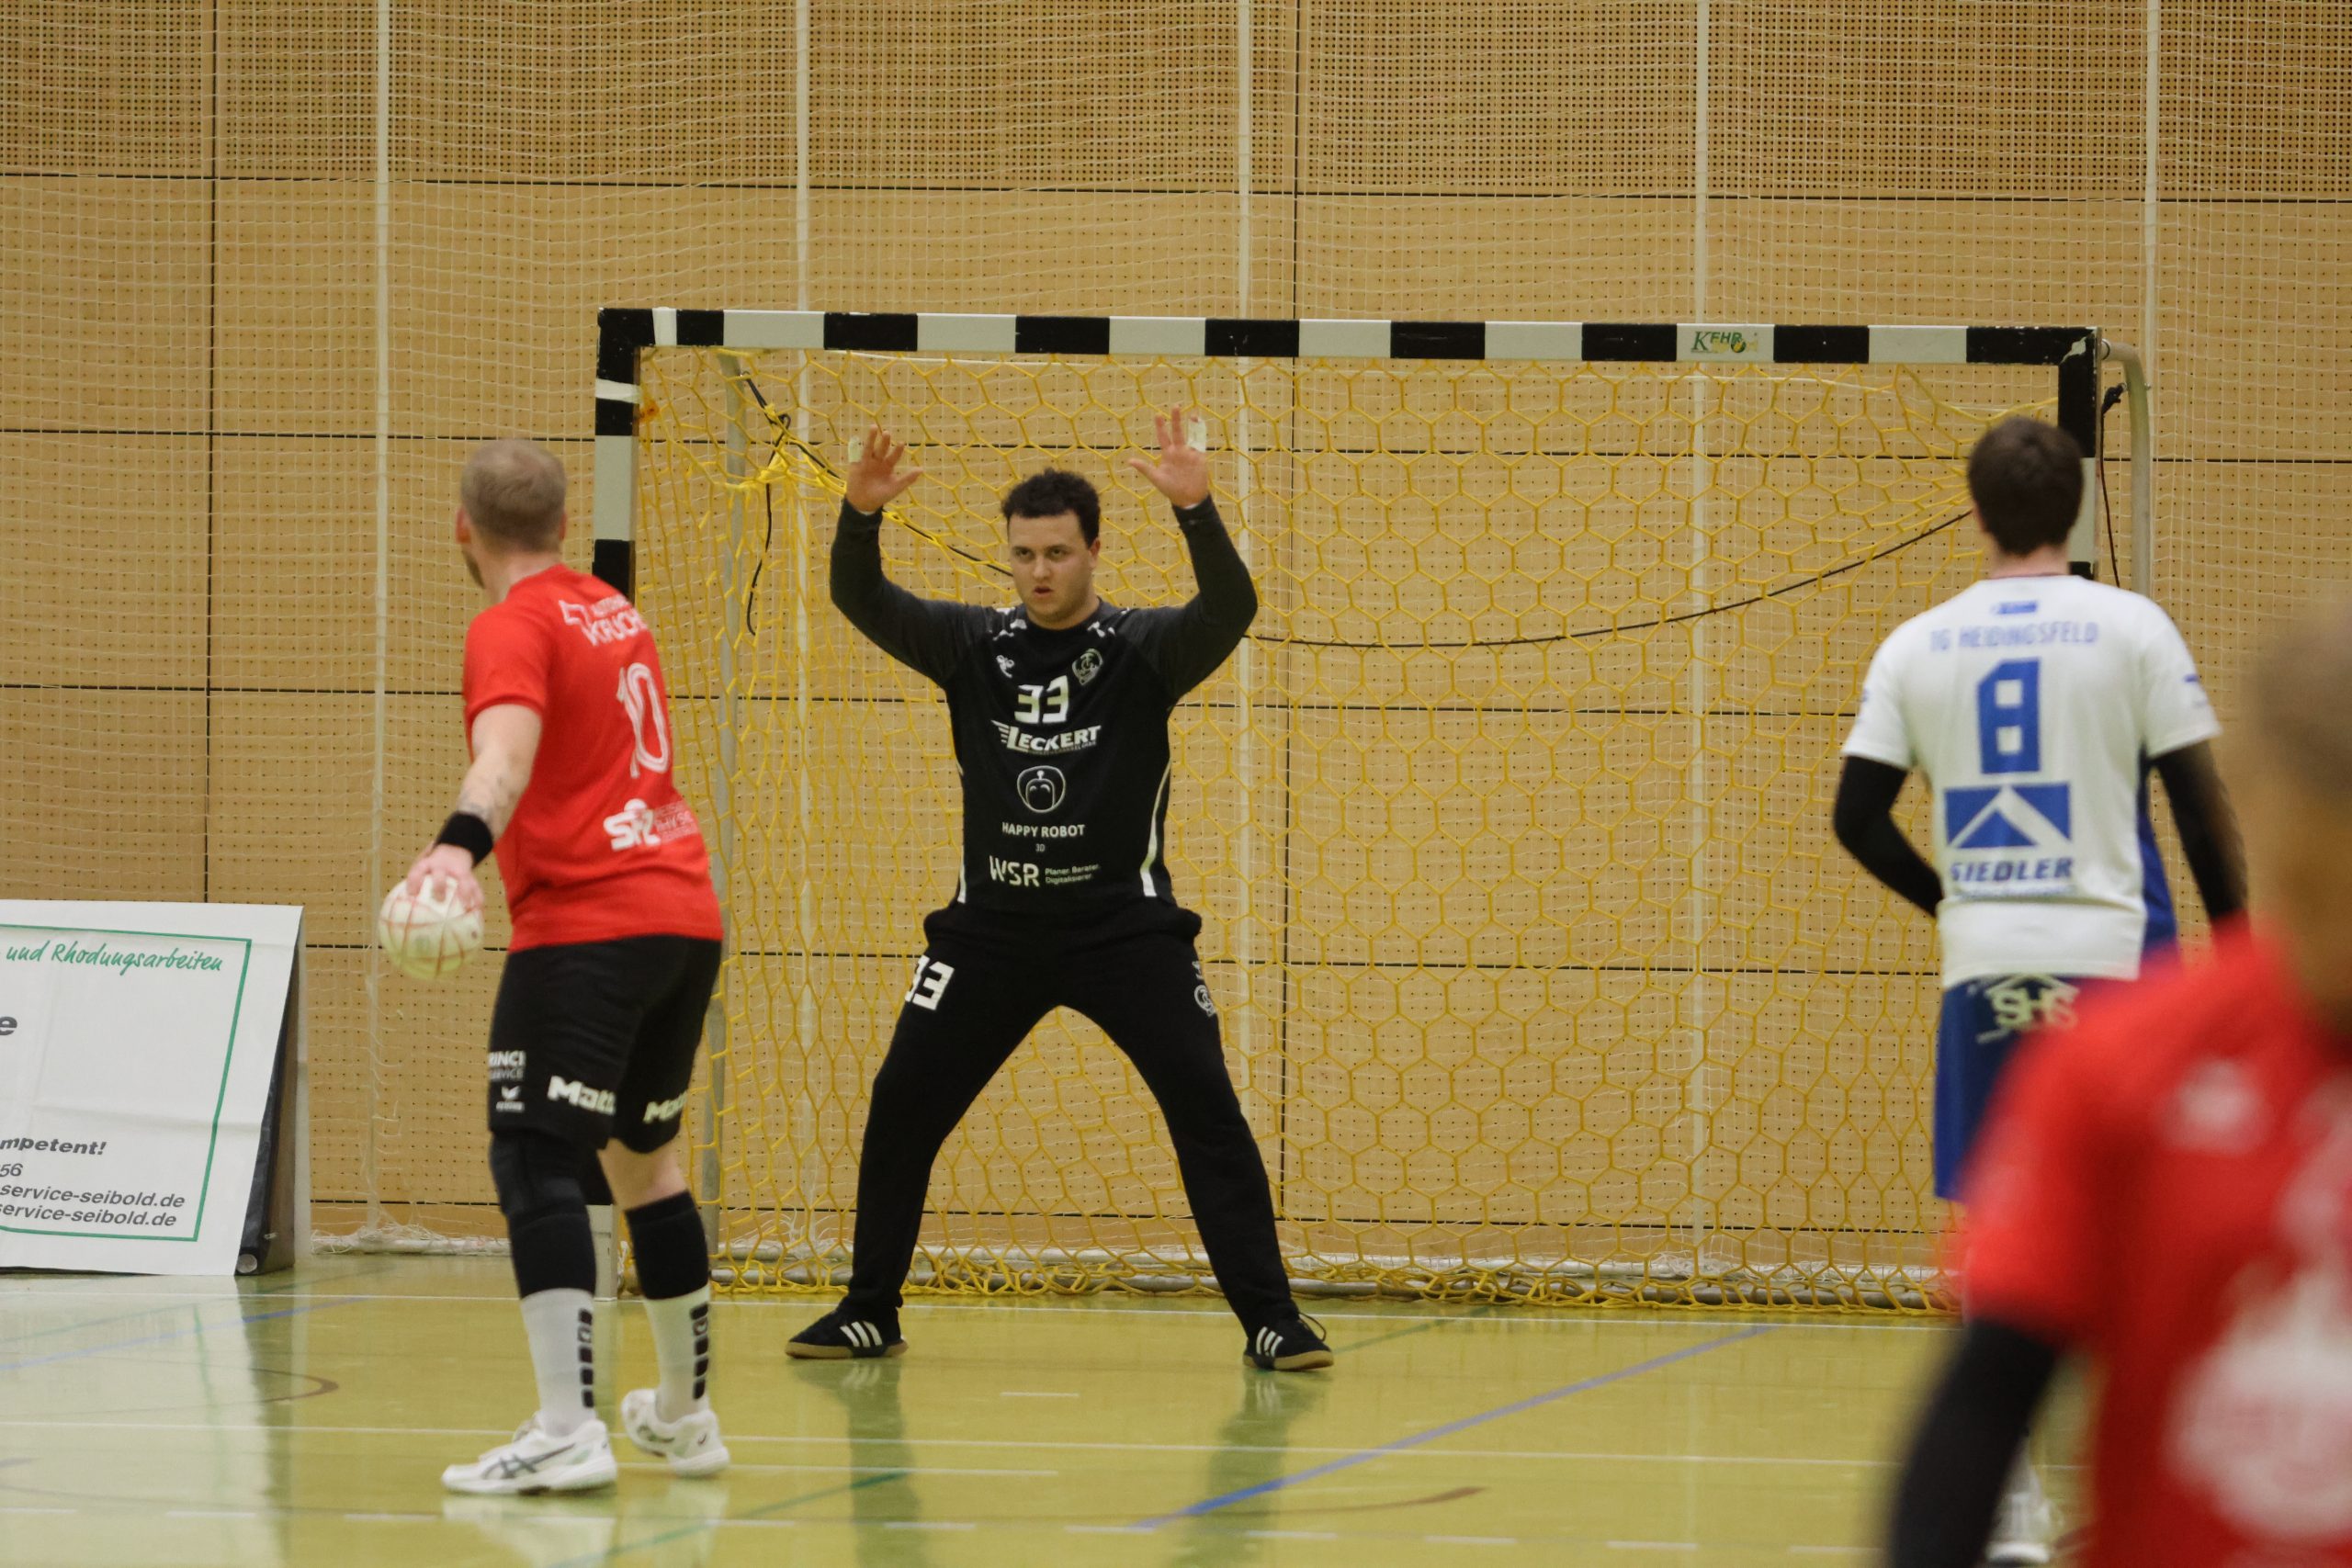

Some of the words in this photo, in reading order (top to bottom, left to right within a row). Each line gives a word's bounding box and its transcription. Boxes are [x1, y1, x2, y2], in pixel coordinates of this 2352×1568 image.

[1013, 675, 1069, 724] 33
[616, 662, 670, 778] 10
[1977, 658, 2041, 774] 8
[1006, 725, 1102, 753] LECKERT
[1001, 821, 1039, 838] HAPPY
[1041, 824, 1086, 839] ROBOT
[989, 855, 1040, 887] WSR
[1950, 856, 2074, 882] SIEDLER
[6, 940, 50, 962] und
[51, 940, 223, 976] Rhodungsarbeiten
[0, 1137, 107, 1156] mpetent!
[0, 1203, 176, 1226] ervice-seibold.de
